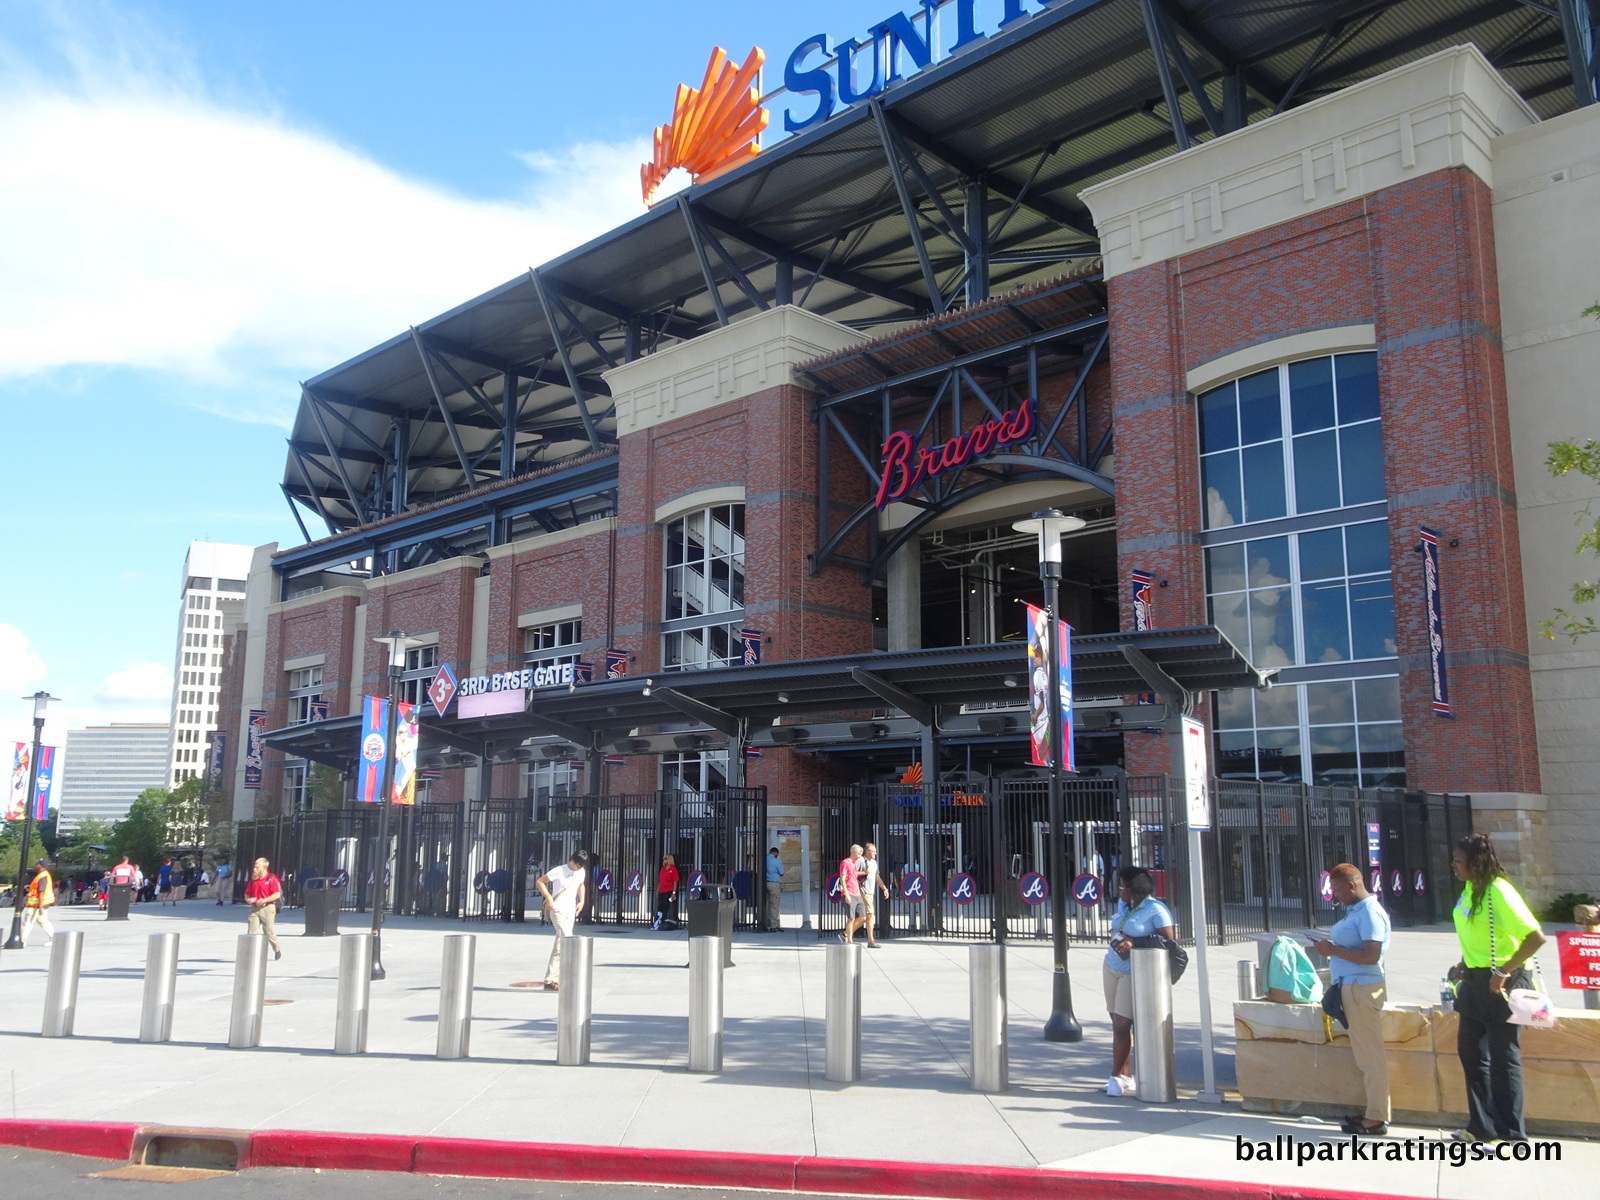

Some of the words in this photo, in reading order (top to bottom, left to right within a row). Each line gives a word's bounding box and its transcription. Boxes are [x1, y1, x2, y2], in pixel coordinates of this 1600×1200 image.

[876, 398, 1036, 512] Braves
[460, 676, 491, 697] 3RD
[492, 668, 532, 692] BASE
[533, 662, 574, 687] GATE
[1569, 976, 1588, 985] 175
